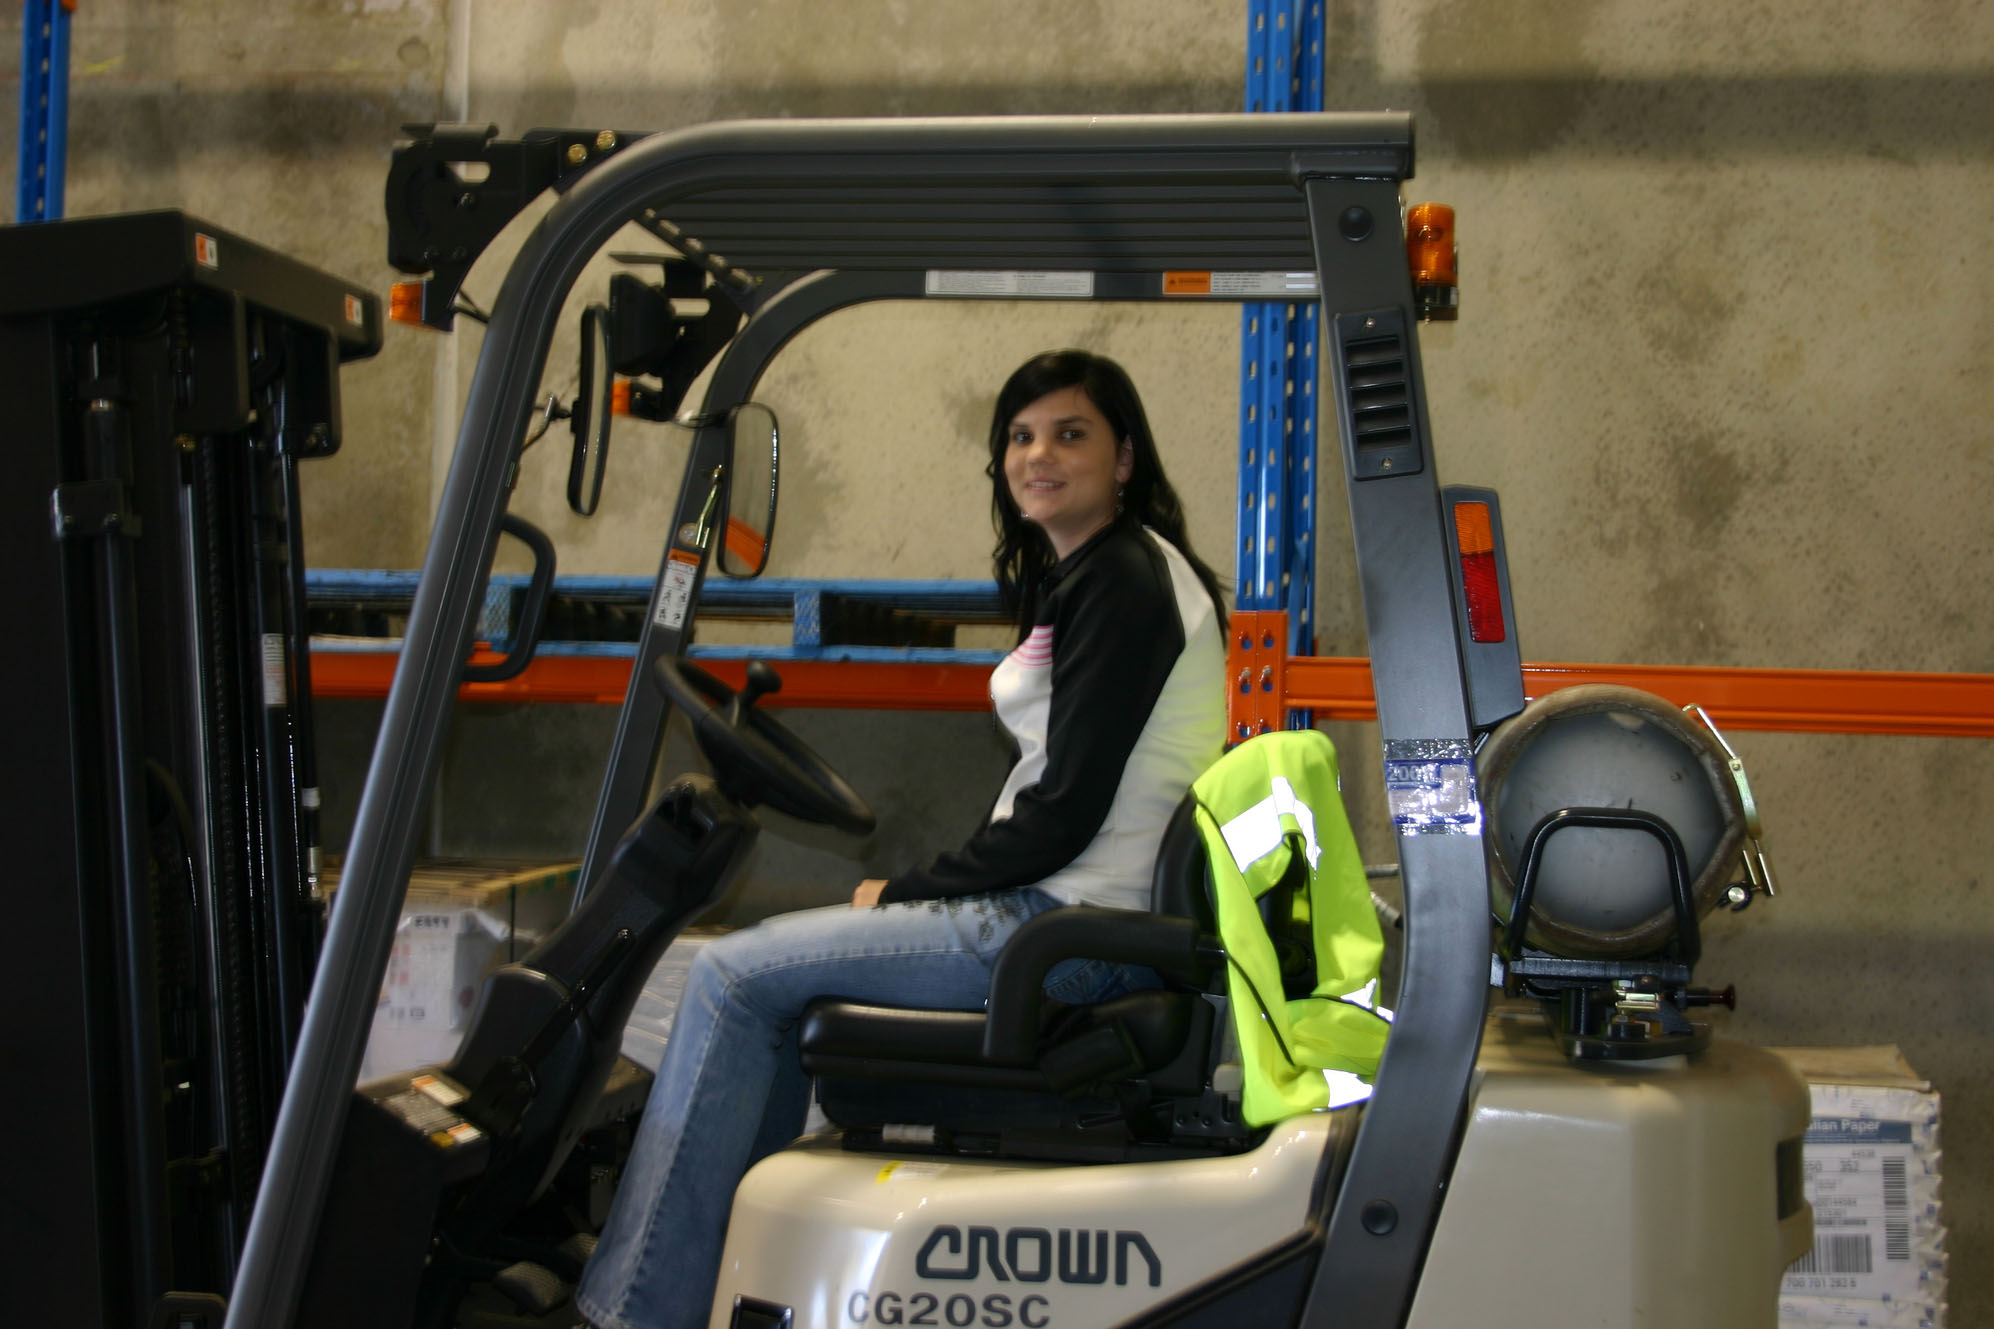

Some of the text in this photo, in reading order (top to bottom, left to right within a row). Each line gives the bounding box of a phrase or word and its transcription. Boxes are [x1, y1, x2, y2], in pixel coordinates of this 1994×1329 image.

[1841, 1119, 1881, 1134] Paper
[916, 1224, 1161, 1287] CROWN
[849, 1291, 1050, 1328] CG20SC
